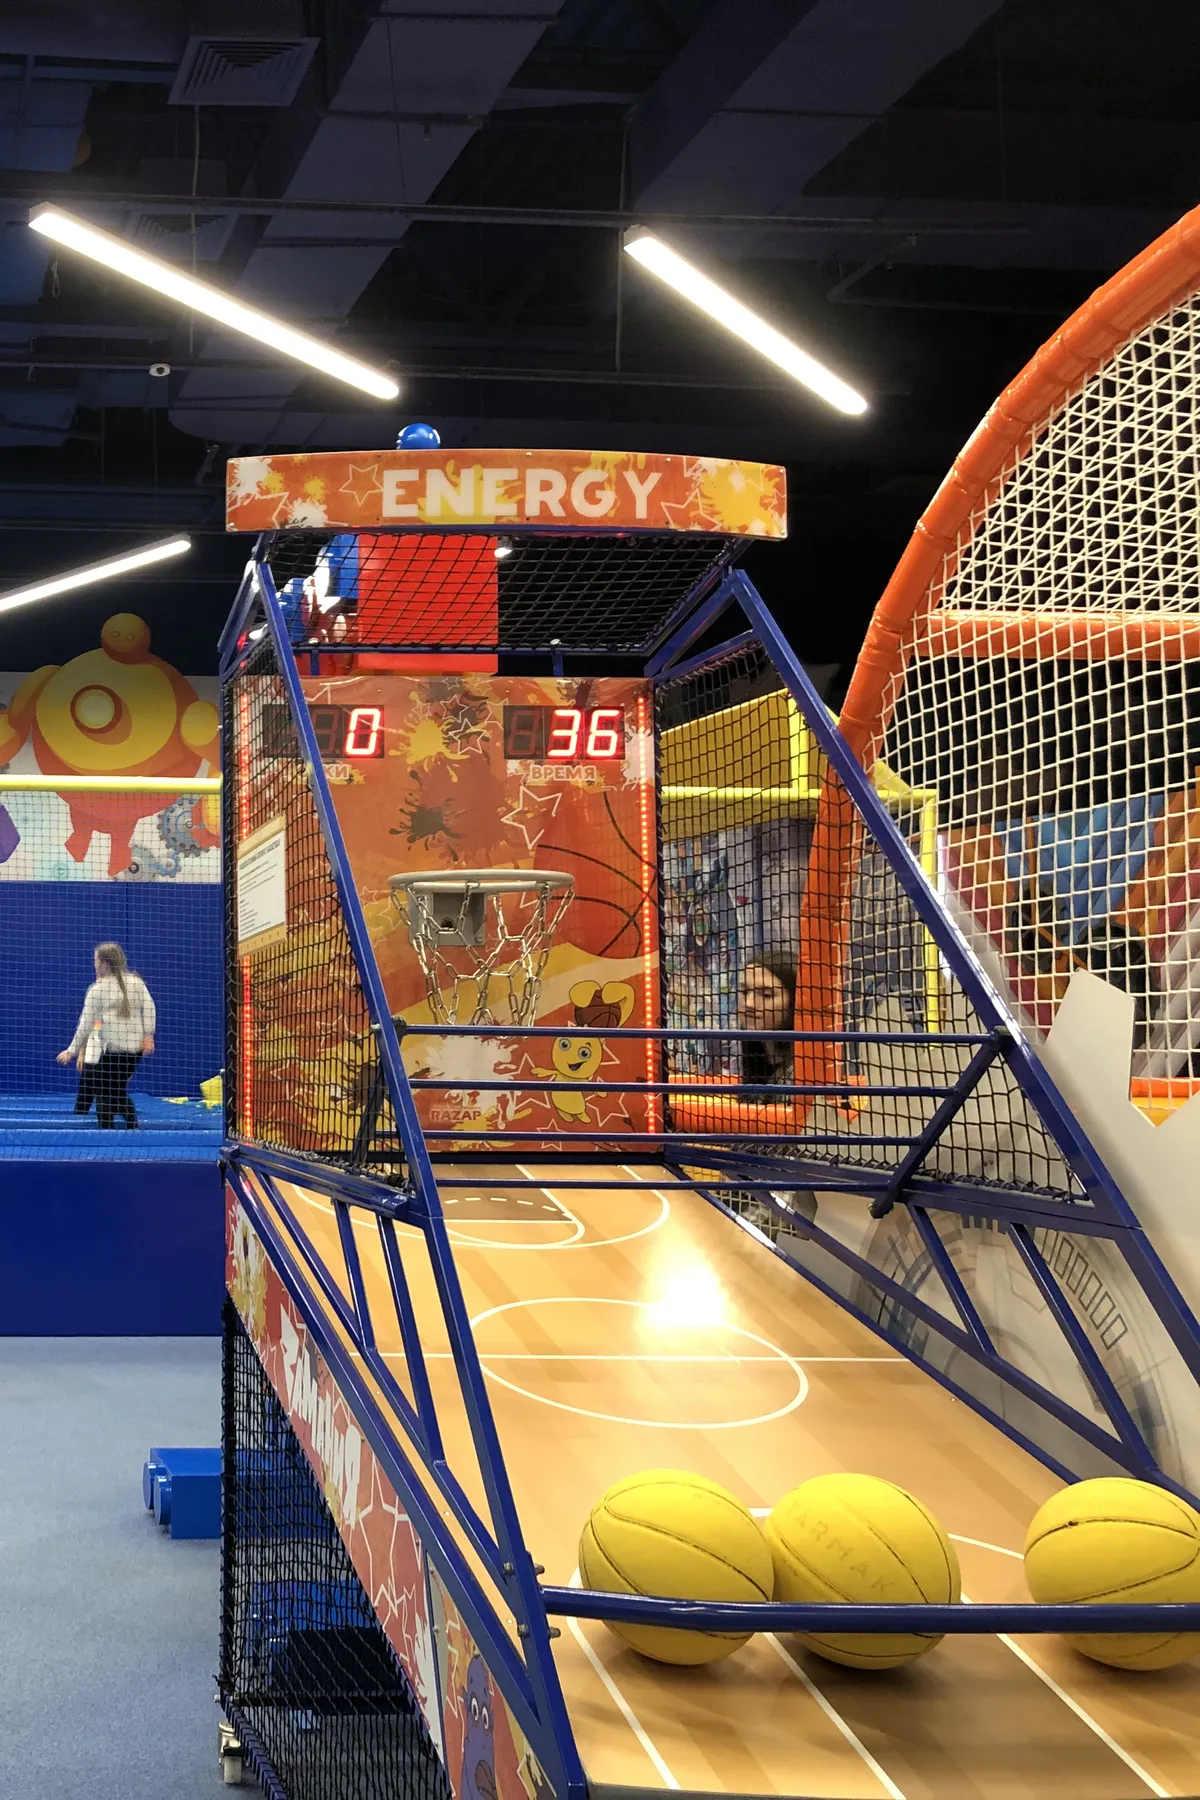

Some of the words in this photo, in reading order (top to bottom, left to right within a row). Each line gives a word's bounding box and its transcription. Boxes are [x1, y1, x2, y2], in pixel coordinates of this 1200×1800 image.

[382, 467, 662, 519] ENERGY
[346, 708, 380, 755] 0
[547, 708, 620, 757] 36
[530, 765, 596, 781] ВРЕМЯ
[431, 1110, 482, 1121] RAZAP
